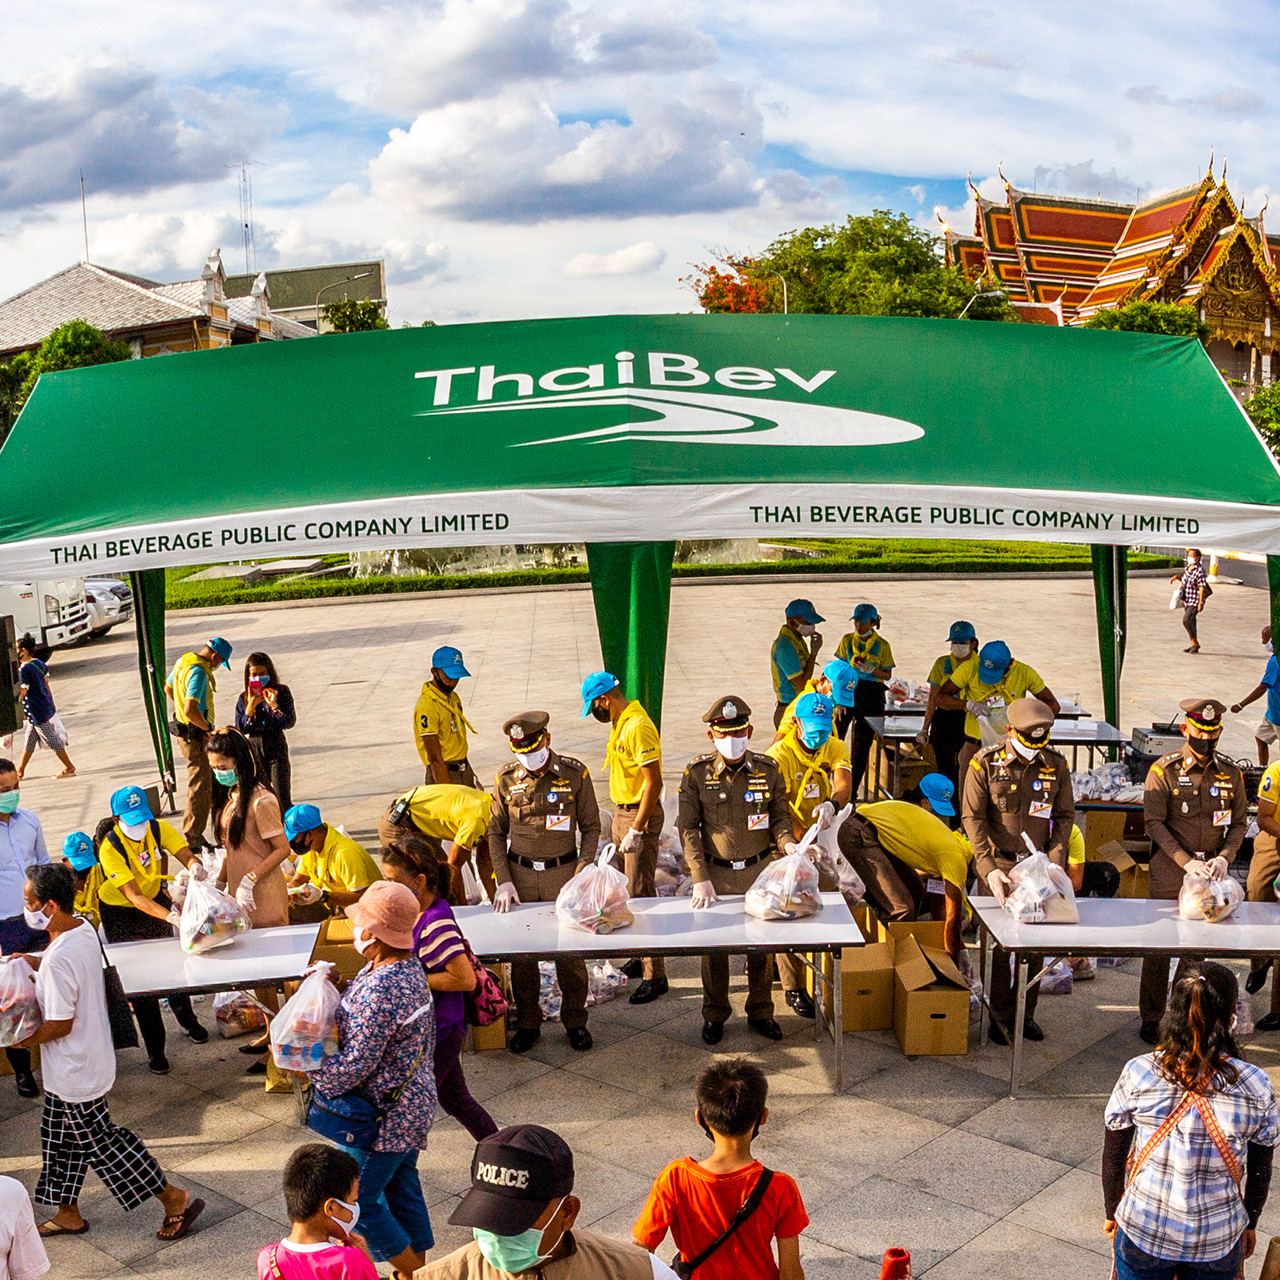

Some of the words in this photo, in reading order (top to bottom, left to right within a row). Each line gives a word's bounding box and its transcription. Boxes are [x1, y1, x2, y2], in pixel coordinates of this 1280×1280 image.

[414, 351, 837, 406] ThaiBev
[749, 505, 801, 523] THAI
[810, 505, 922, 524] BEVERAGE
[930, 506, 1005, 526] PUBLIC
[1012, 509, 1114, 530] COMPANY
[1121, 514, 1200, 534] LIMITED
[49, 542, 98, 565] THAI
[105, 530, 213, 558] BEVERAGE
[221, 524, 297, 547] PUBLIC
[304, 516, 413, 540] COMPANY
[421, 513, 509, 533] LIMITED
[1262, 777, 1272, 792] 3
[476, 1161, 529, 1189] POLICE
